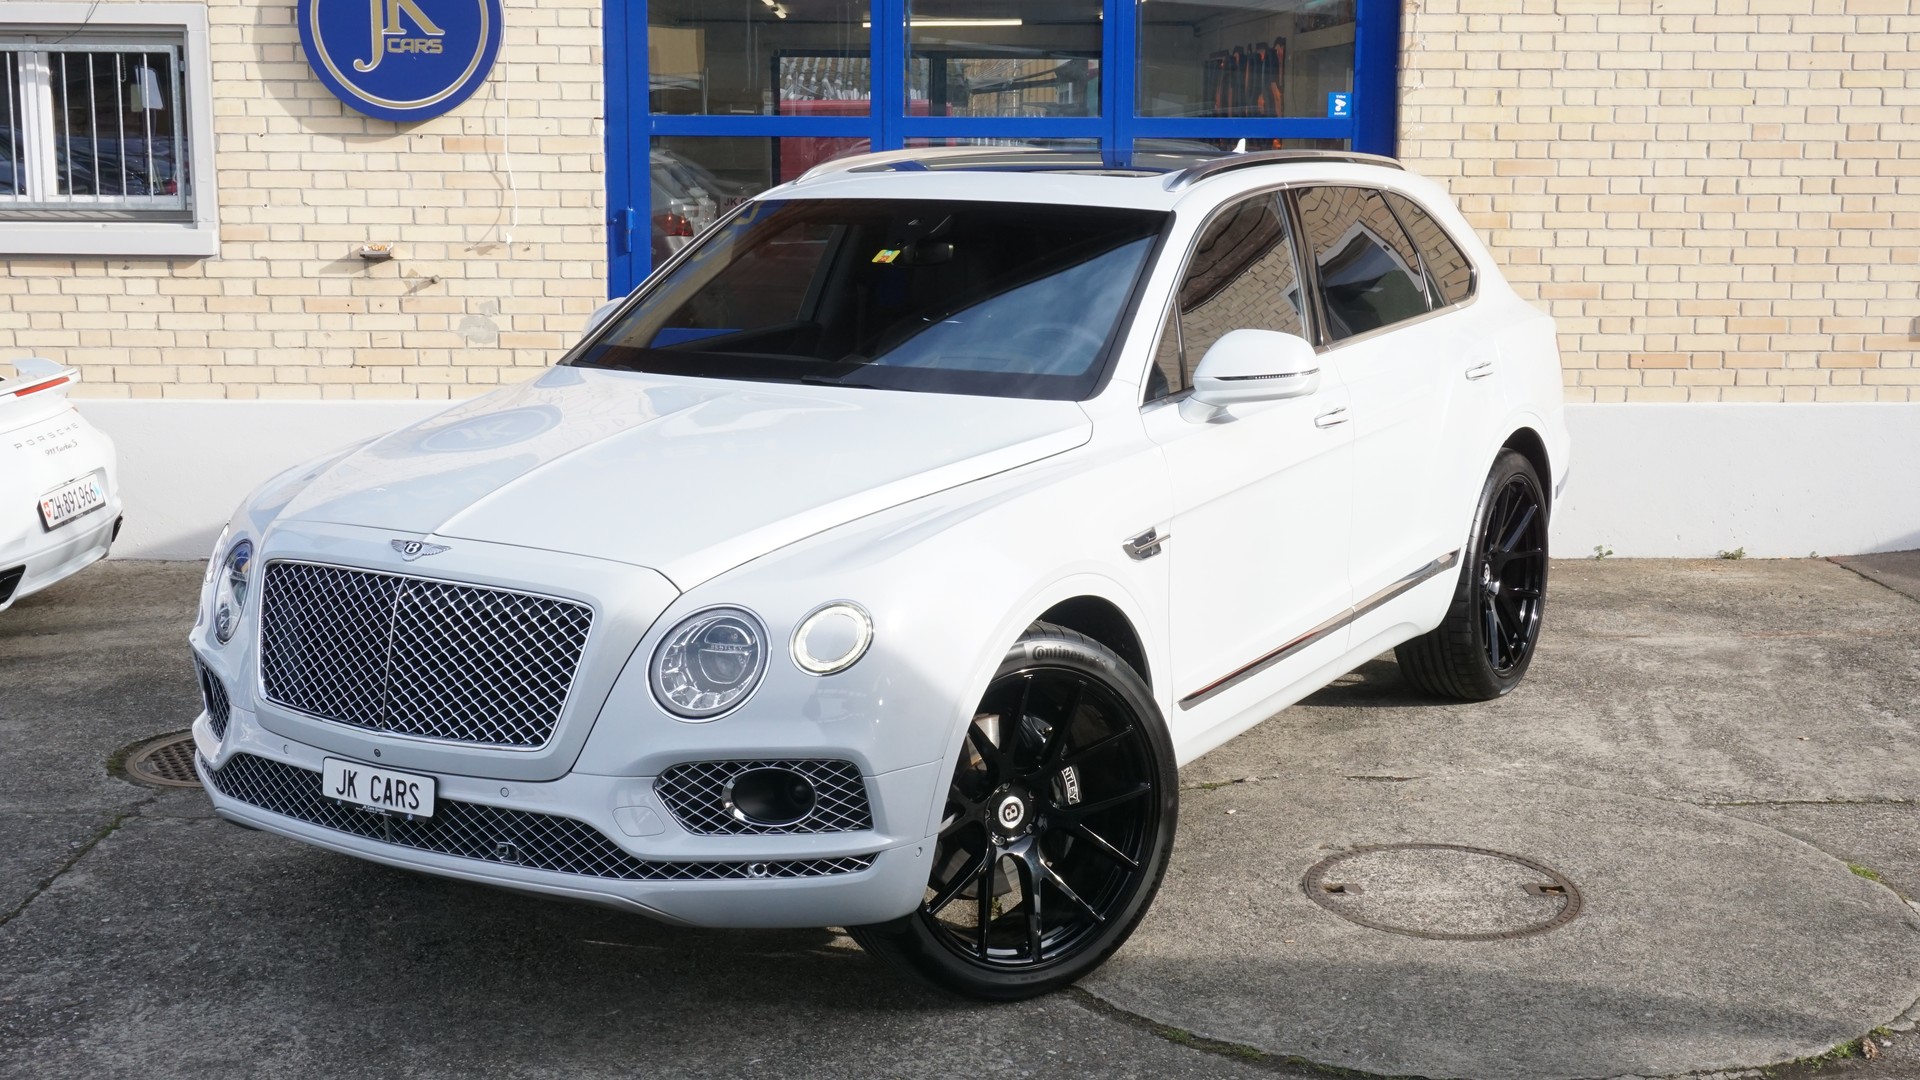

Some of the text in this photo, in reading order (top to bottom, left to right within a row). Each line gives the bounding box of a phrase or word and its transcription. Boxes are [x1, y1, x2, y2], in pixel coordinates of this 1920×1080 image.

[387, 38, 443, 54] CARS
[14, 422, 79, 449] PORSCHE
[336, 768, 420, 810] JK CARS
[1063, 767, 1077, 800] NTLEY
